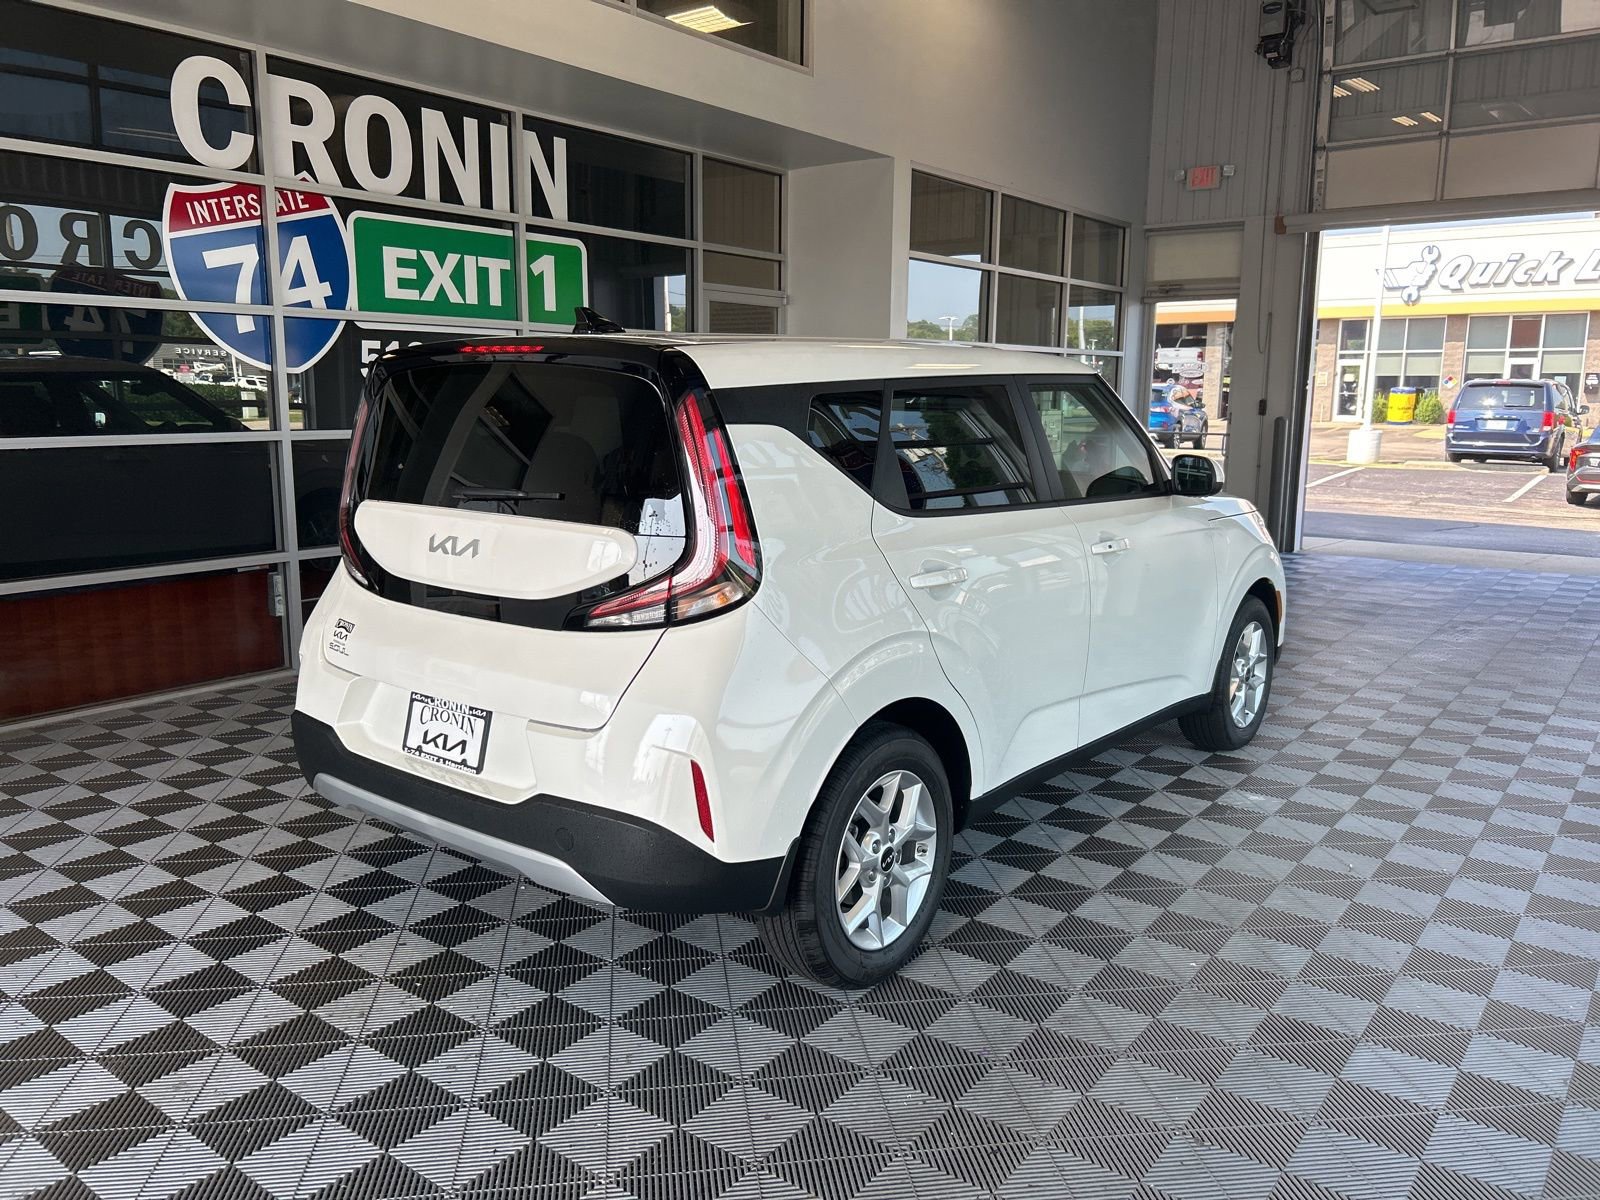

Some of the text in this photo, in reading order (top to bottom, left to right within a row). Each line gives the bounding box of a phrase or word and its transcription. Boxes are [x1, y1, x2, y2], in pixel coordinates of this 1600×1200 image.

[170, 55, 568, 222] CRONIN
[186, 190, 309, 225] INTERSATE
[202, 235, 333, 334] 74
[382, 245, 557, 312] EXIT 1
[1438, 250, 1575, 293] Quick
[428, 533, 480, 559] KIA
[333, 629, 348, 641] KIA
[420, 705, 477, 739] CRONIN
[422, 729, 467, 756] KIA
